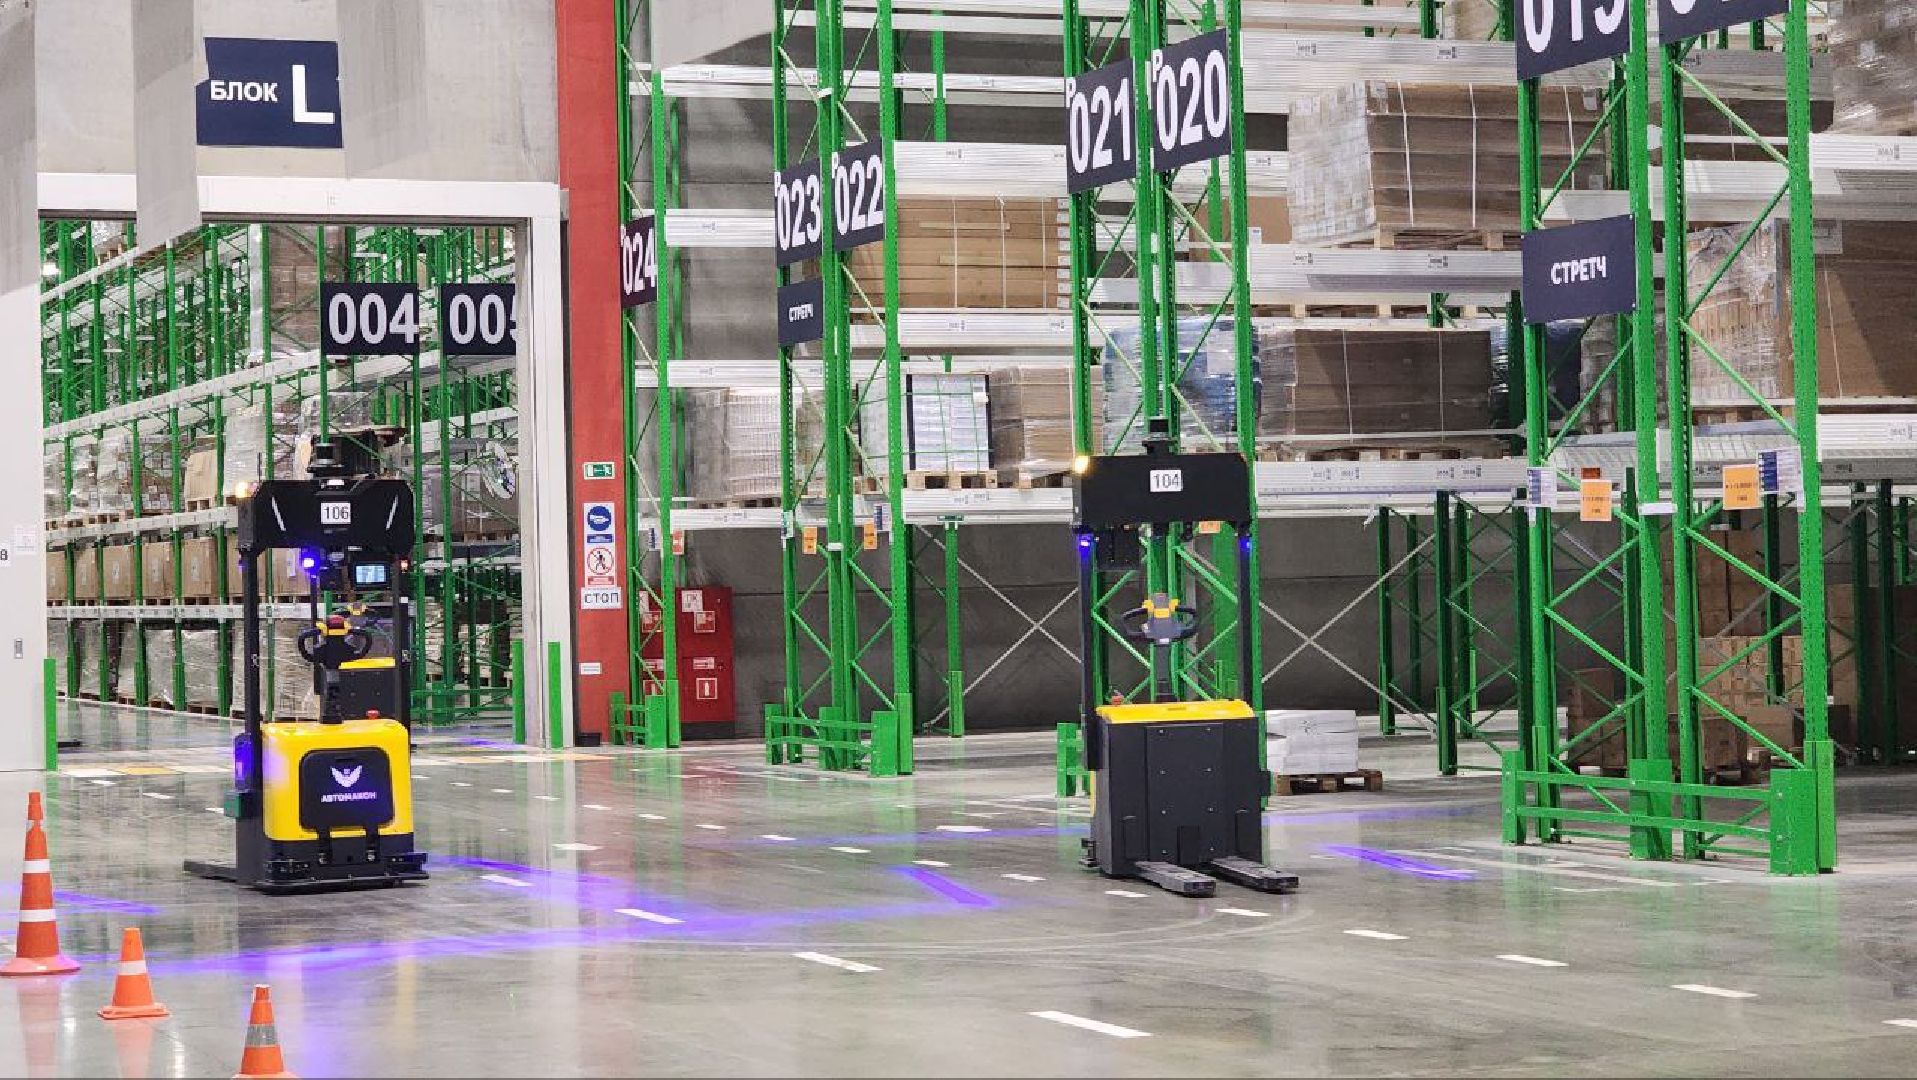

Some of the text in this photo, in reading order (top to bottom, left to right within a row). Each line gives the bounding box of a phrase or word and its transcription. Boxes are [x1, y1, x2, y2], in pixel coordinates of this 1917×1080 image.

[210, 64, 336, 124] БЛОК L
[1157, 49, 1227, 151] 020
[1069, 78, 1131, 174] 021
[777, 174, 821, 251] 023
[834, 154, 884, 236] 022
[622, 228, 658, 296] 024
[1550, 255, 1607, 285] СТРЕТЧ
[328, 292, 420, 345] 004
[449, 294, 516, 345] 00
[1153, 473, 1181, 489] 104
[323, 506, 349, 520] 106
[584, 592, 620, 604] СТОП
